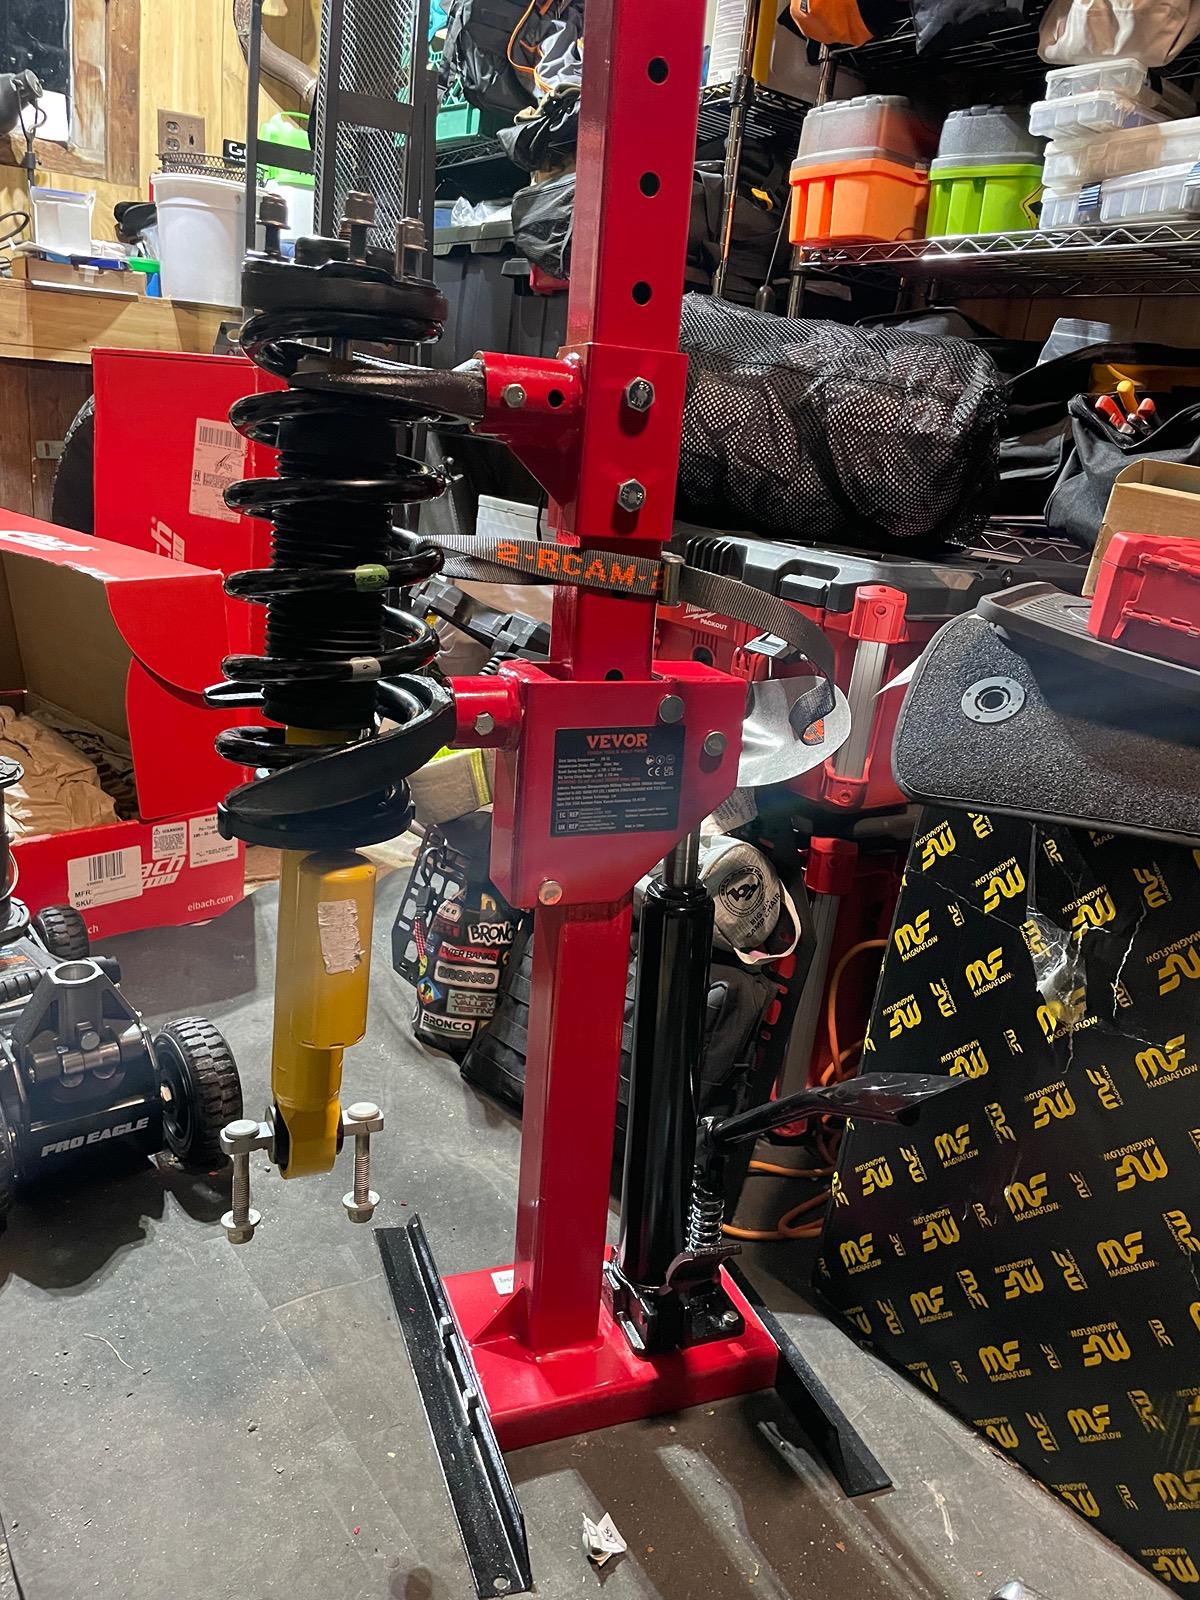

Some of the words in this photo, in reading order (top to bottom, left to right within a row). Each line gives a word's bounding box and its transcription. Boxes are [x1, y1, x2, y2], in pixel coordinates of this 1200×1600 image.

[700, 618, 728, 630] PACKOUT
[586, 733, 648, 749] VEVOR
[141, 855, 186, 879] ach
[75, 889, 93, 898] MFR:
[187, 894, 234, 912] eibach.com
[76, 899, 94, 908] SKU:
[746, 917, 765, 938] CAMP
[765, 892, 781, 918] CHAIR
[750, 911, 763, 926] BIG
[468, 922, 514, 946] BRONC
[466, 950, 497, 961] BANKS
[901, 935, 938, 963] MAGNAFLOW
[437, 966, 496, 985] BRONCO
[973, 972, 1013, 998] MAGNAFLOW
[454, 1000, 494, 1008] VALLEY
[422, 1013, 473, 1031] BRONCO
[1146, 1063, 1199, 1089] MAGNAFLOW
[41, 1135, 85, 1158] PRO
[86, 1117, 150, 1145] EAGLE
[1103, 1137, 1156, 1162] MAGNAFLOW
[1014, 1201, 1060, 1223] MAGNAFLOW
[1108, 1259, 1156, 1279] MAGNAFLOW
